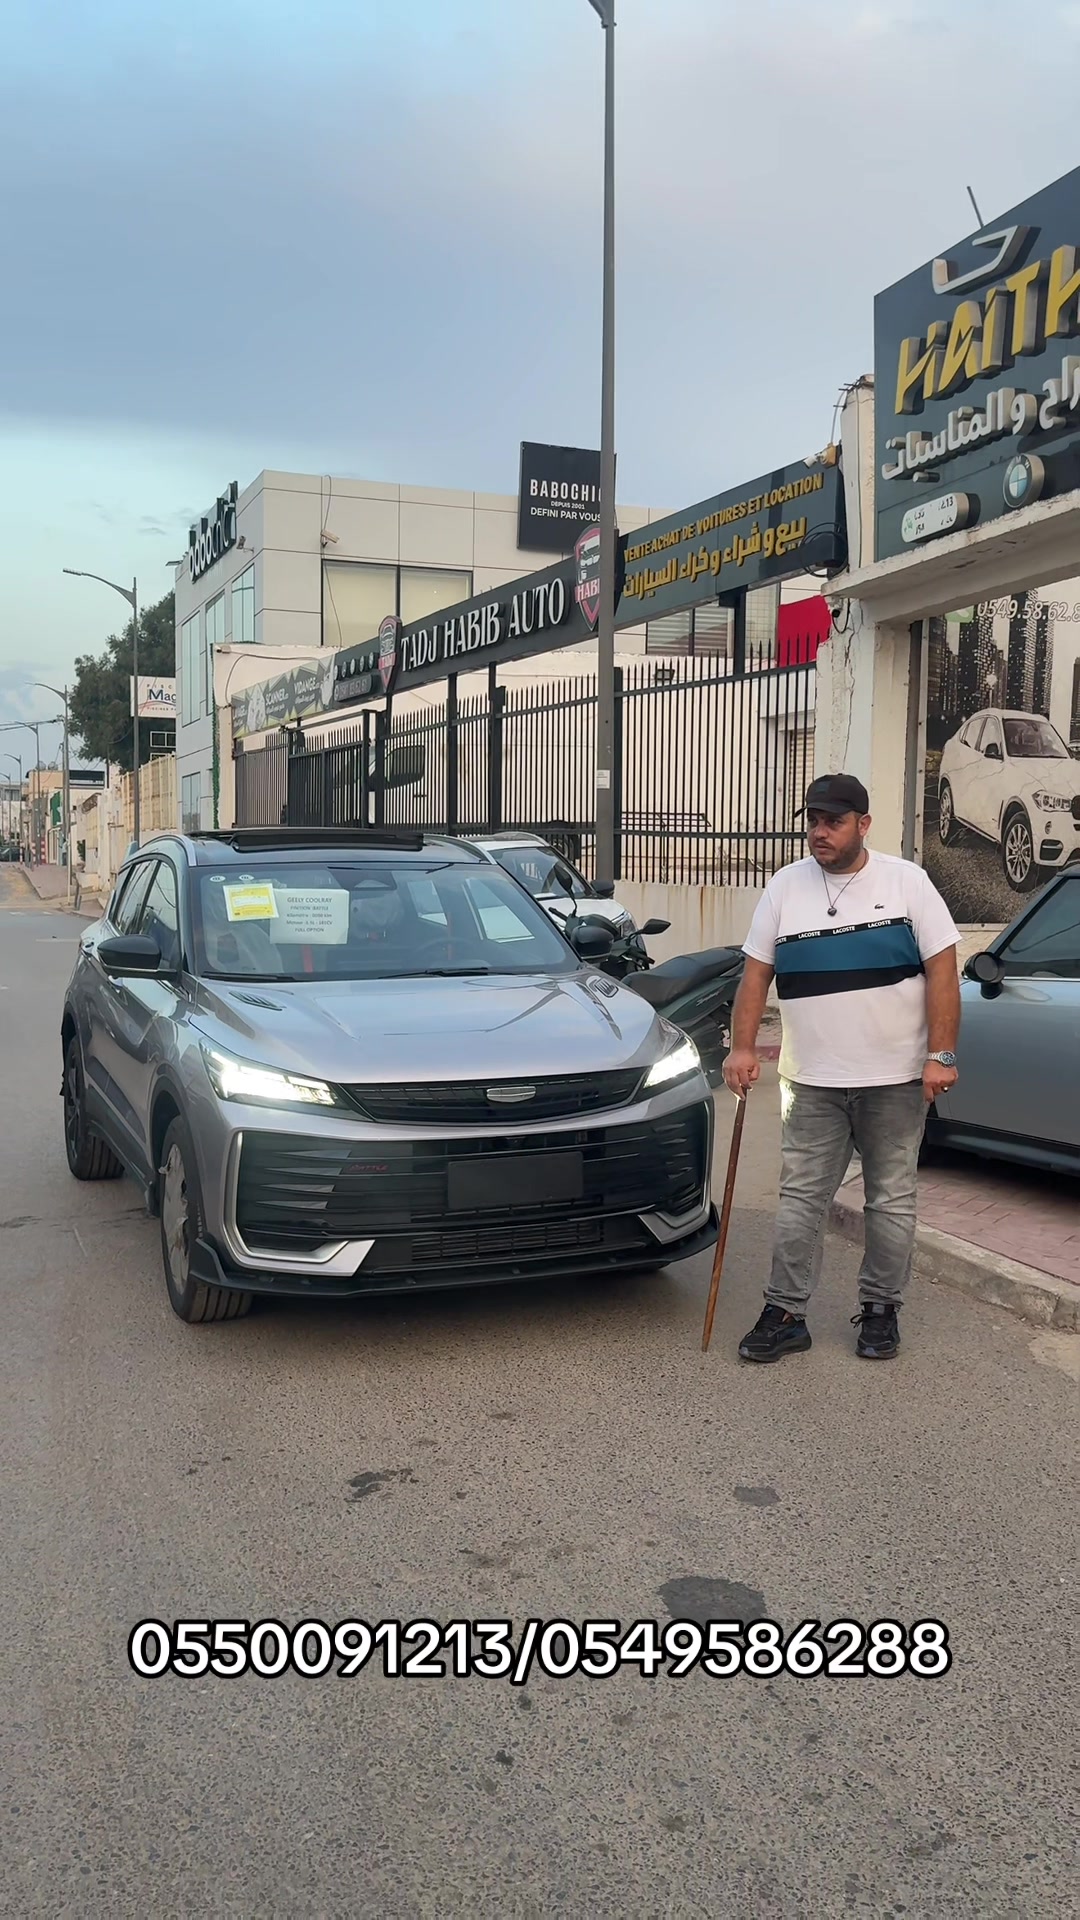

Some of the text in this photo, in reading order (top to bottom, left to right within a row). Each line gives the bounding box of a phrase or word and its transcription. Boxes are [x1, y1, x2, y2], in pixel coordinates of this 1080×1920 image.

[1040, 355, 1080, 430] راح
[530, 479, 601, 502] BABOCHI
[530, 507, 559, 518] DEFINI
[560, 510, 578, 520] PAR
[624, 472, 824, 563] VENTE ACHAT DE VOITURES ET LOCATION
[577, 577, 600, 601] HABI
[401, 577, 566, 673] TADJ HABIB AUTO
[149, 689, 176, 704] Mag
[798, 930, 821, 940] LACOSTE
[832, 925, 856, 935] LACOSTE
[867, 919, 892, 928] LACOSTE
